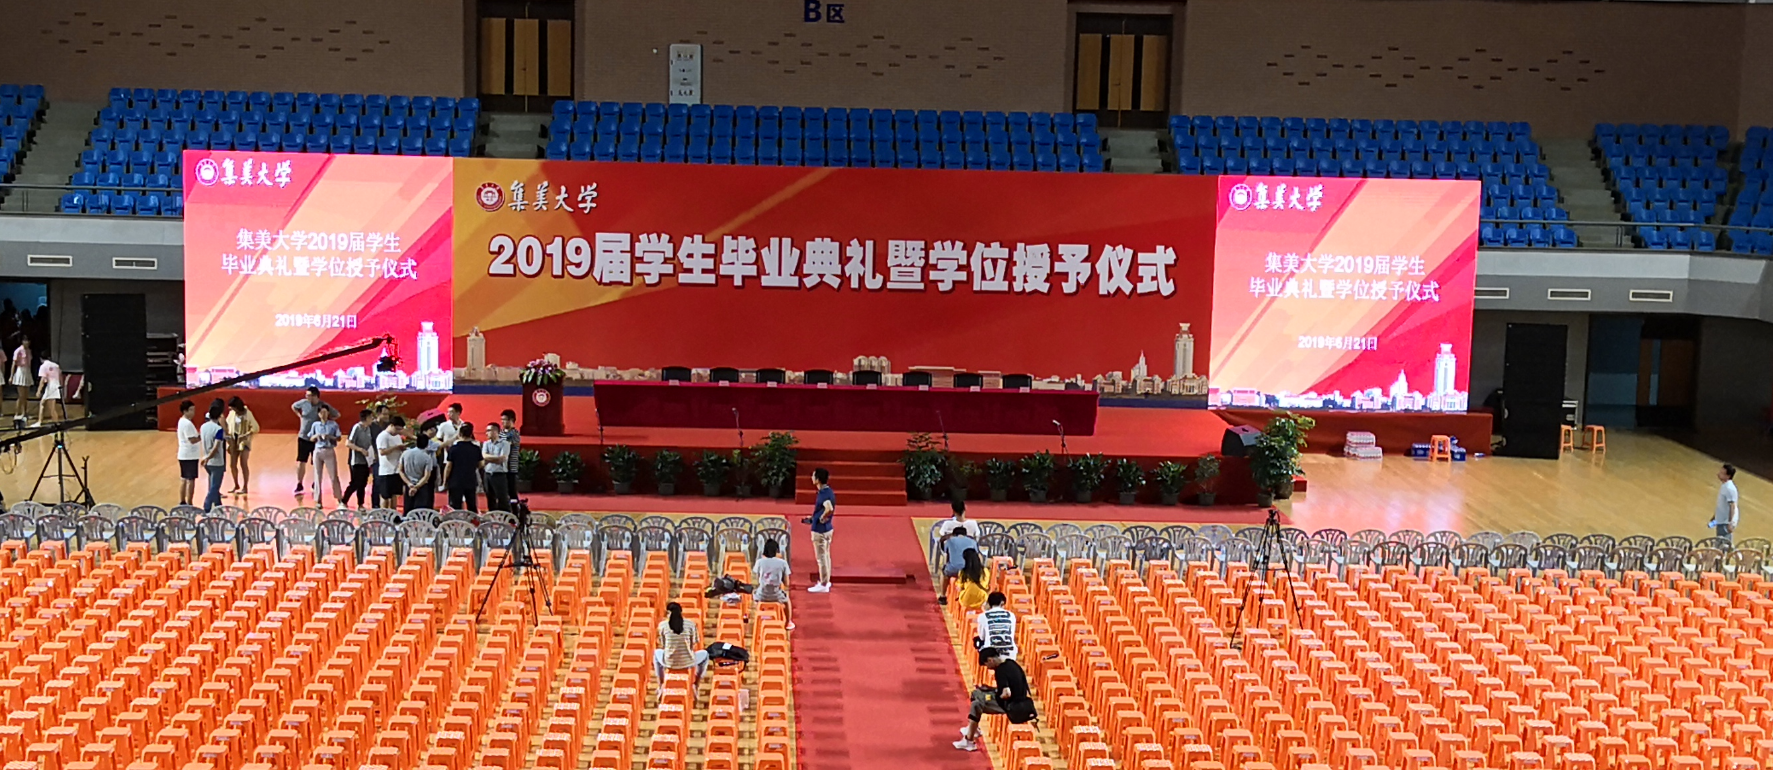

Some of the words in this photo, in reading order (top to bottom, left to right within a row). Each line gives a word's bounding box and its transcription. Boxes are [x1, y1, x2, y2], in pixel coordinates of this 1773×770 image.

[221, 158, 292, 188] 集美大学
[507, 180, 599, 214] 集美大学
[1253, 182, 1324, 211] 集美大学
[236, 228, 402, 253] 集美大学2019届学生
[221, 253, 418, 280] 毕业典礼暨学位授予仪式
[488, 231, 1178, 297] 2019届学生毕业典礼暨学位授予仪式
[1265, 252, 1426, 276] 集美大学2019届学生
[1249, 277, 1440, 302] 毕业典礼暨学位授予仪式
[274, 313, 358, 329] 2019年6月21日
[1297, 336, 1378, 351] 2019年6月21日
